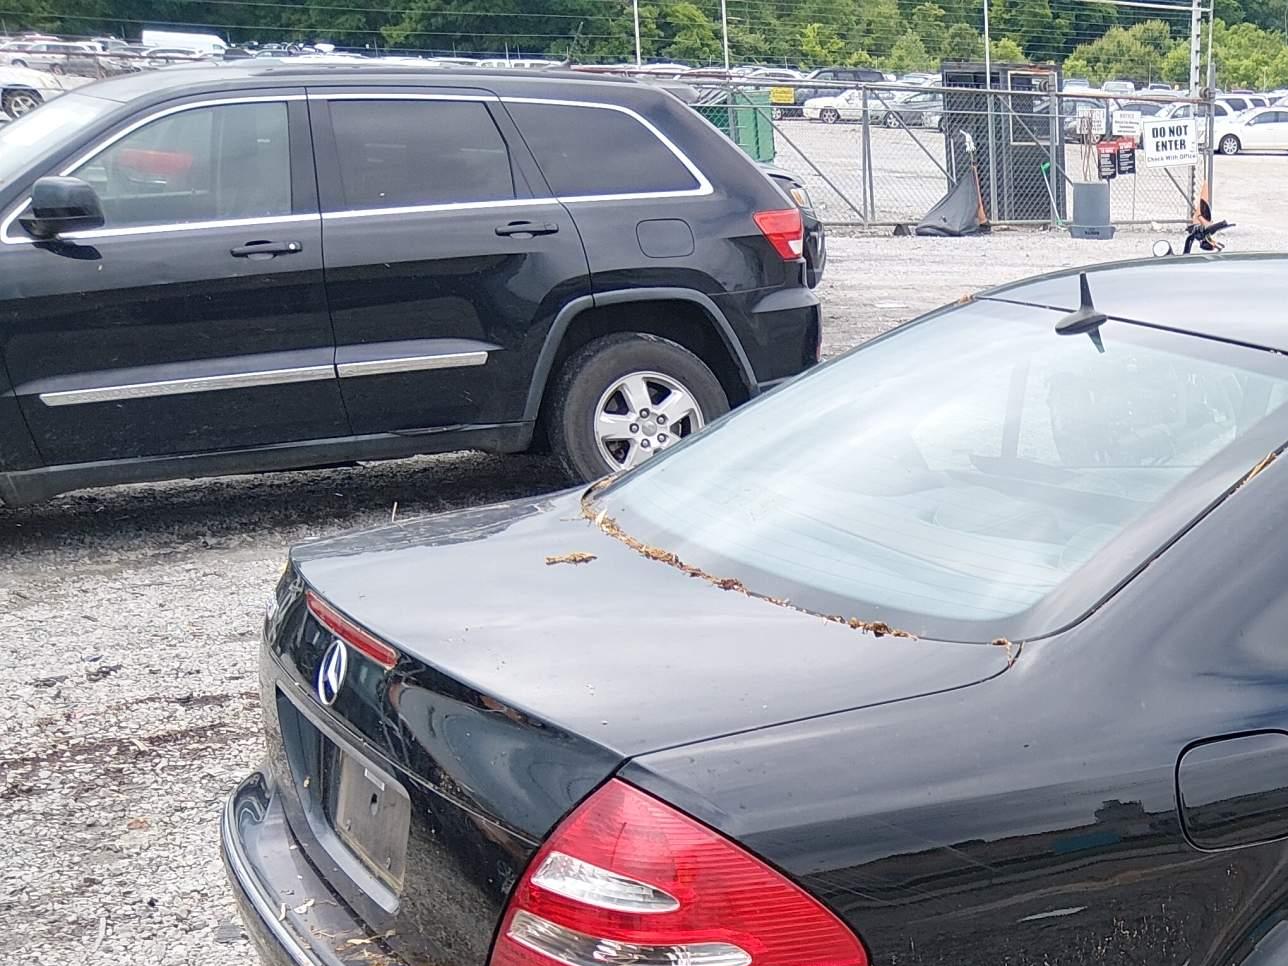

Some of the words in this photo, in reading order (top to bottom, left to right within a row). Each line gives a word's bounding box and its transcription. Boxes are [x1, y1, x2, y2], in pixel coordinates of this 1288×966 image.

[1152, 127, 1166, 138] DO
[1168, 125, 1188, 137] NOT
[1155, 139, 1186, 152] ENTER
